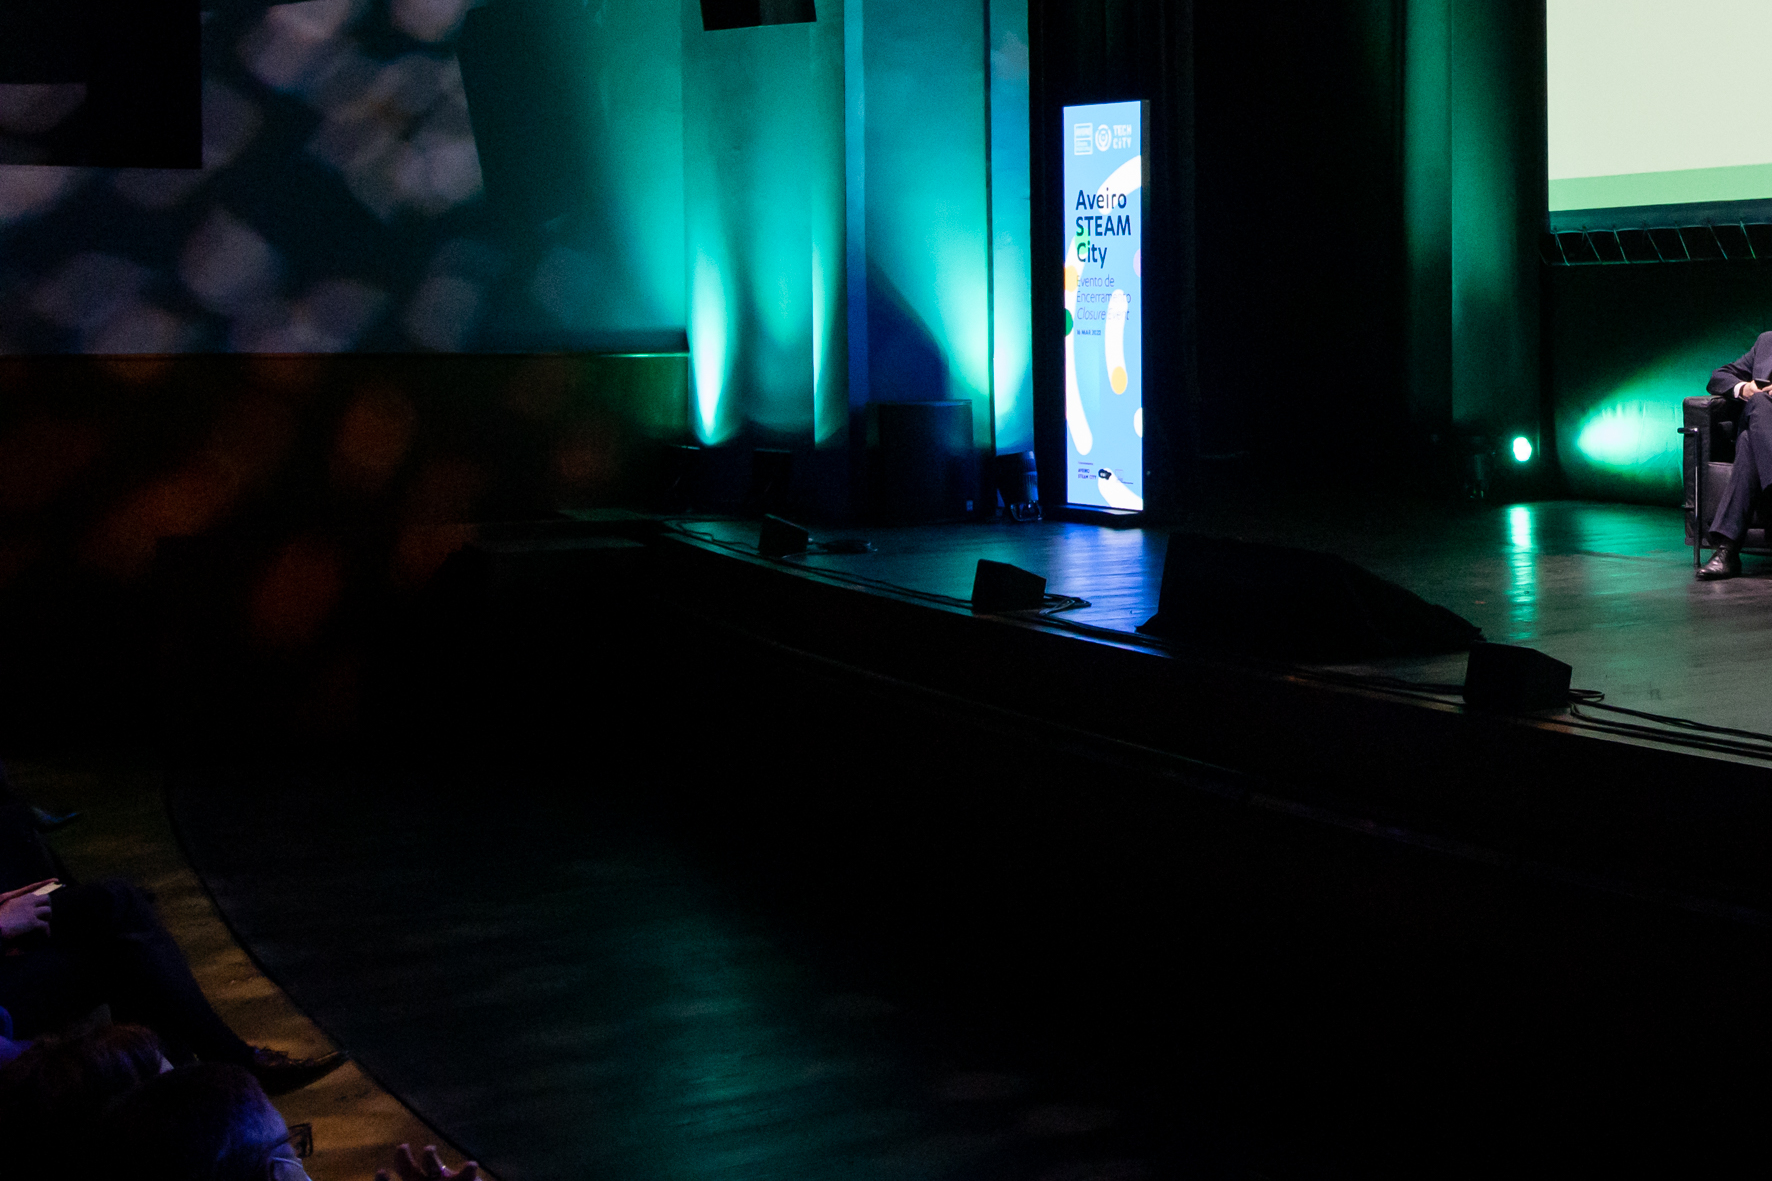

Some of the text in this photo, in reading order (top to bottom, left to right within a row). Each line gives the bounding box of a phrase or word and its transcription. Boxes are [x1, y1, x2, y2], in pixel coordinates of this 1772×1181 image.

[1112, 123, 1132, 136] TECH
[1075, 187, 1127, 210] Aveiro
[1075, 215, 1131, 236] STEAM
[1077, 240, 1108, 269] City
[1076, 273, 1115, 288] Evento de
[1076, 306, 1106, 321] Closure
